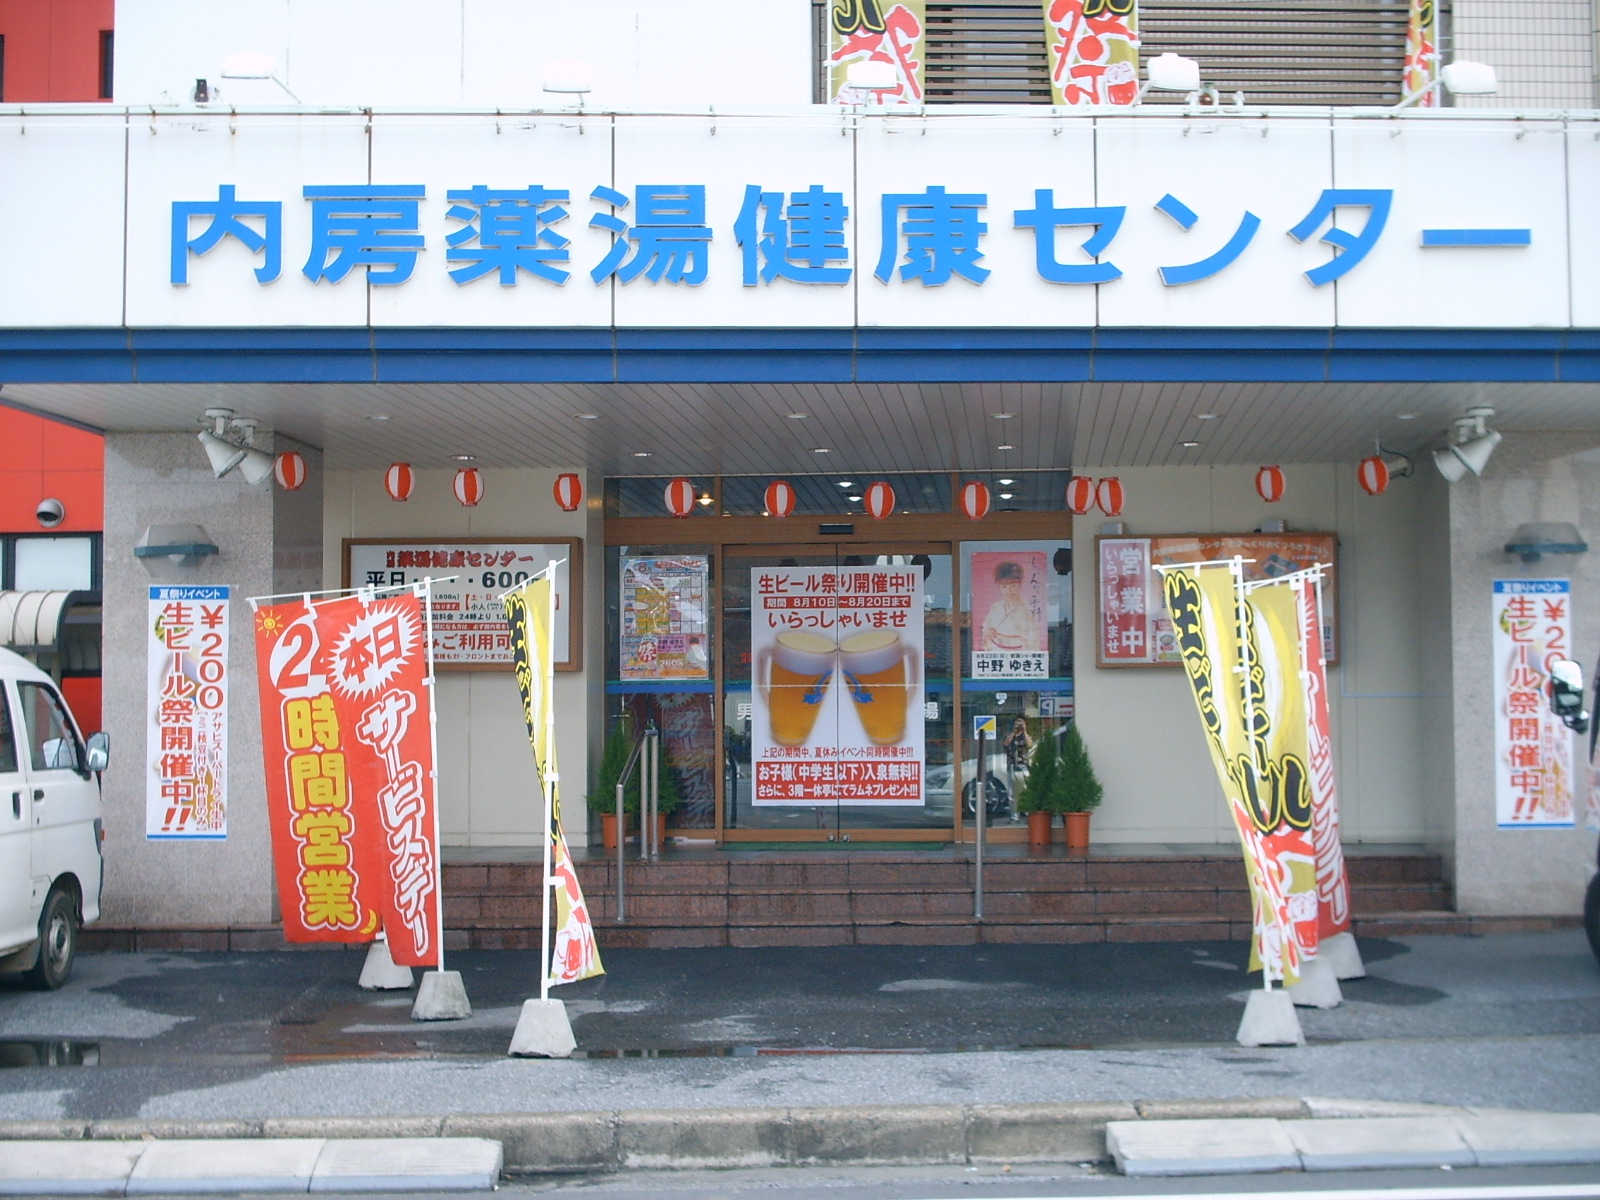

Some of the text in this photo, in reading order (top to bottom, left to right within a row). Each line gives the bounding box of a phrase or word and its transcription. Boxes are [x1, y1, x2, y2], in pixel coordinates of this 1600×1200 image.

[171, 184, 1531, 290] 内房薬湯健康センター
[758, 573, 916, 594] 生ビール祭り開催中!!
[766, 598, 788, 608] 期間
[1105, 547, 1120, 653] いらっしゃいませ
[1119, 547, 1145, 655] 営業中
[768, 610, 908, 629] いらっしゃいませ
[977, 660, 1045, 672] 中野 ゆきえ
